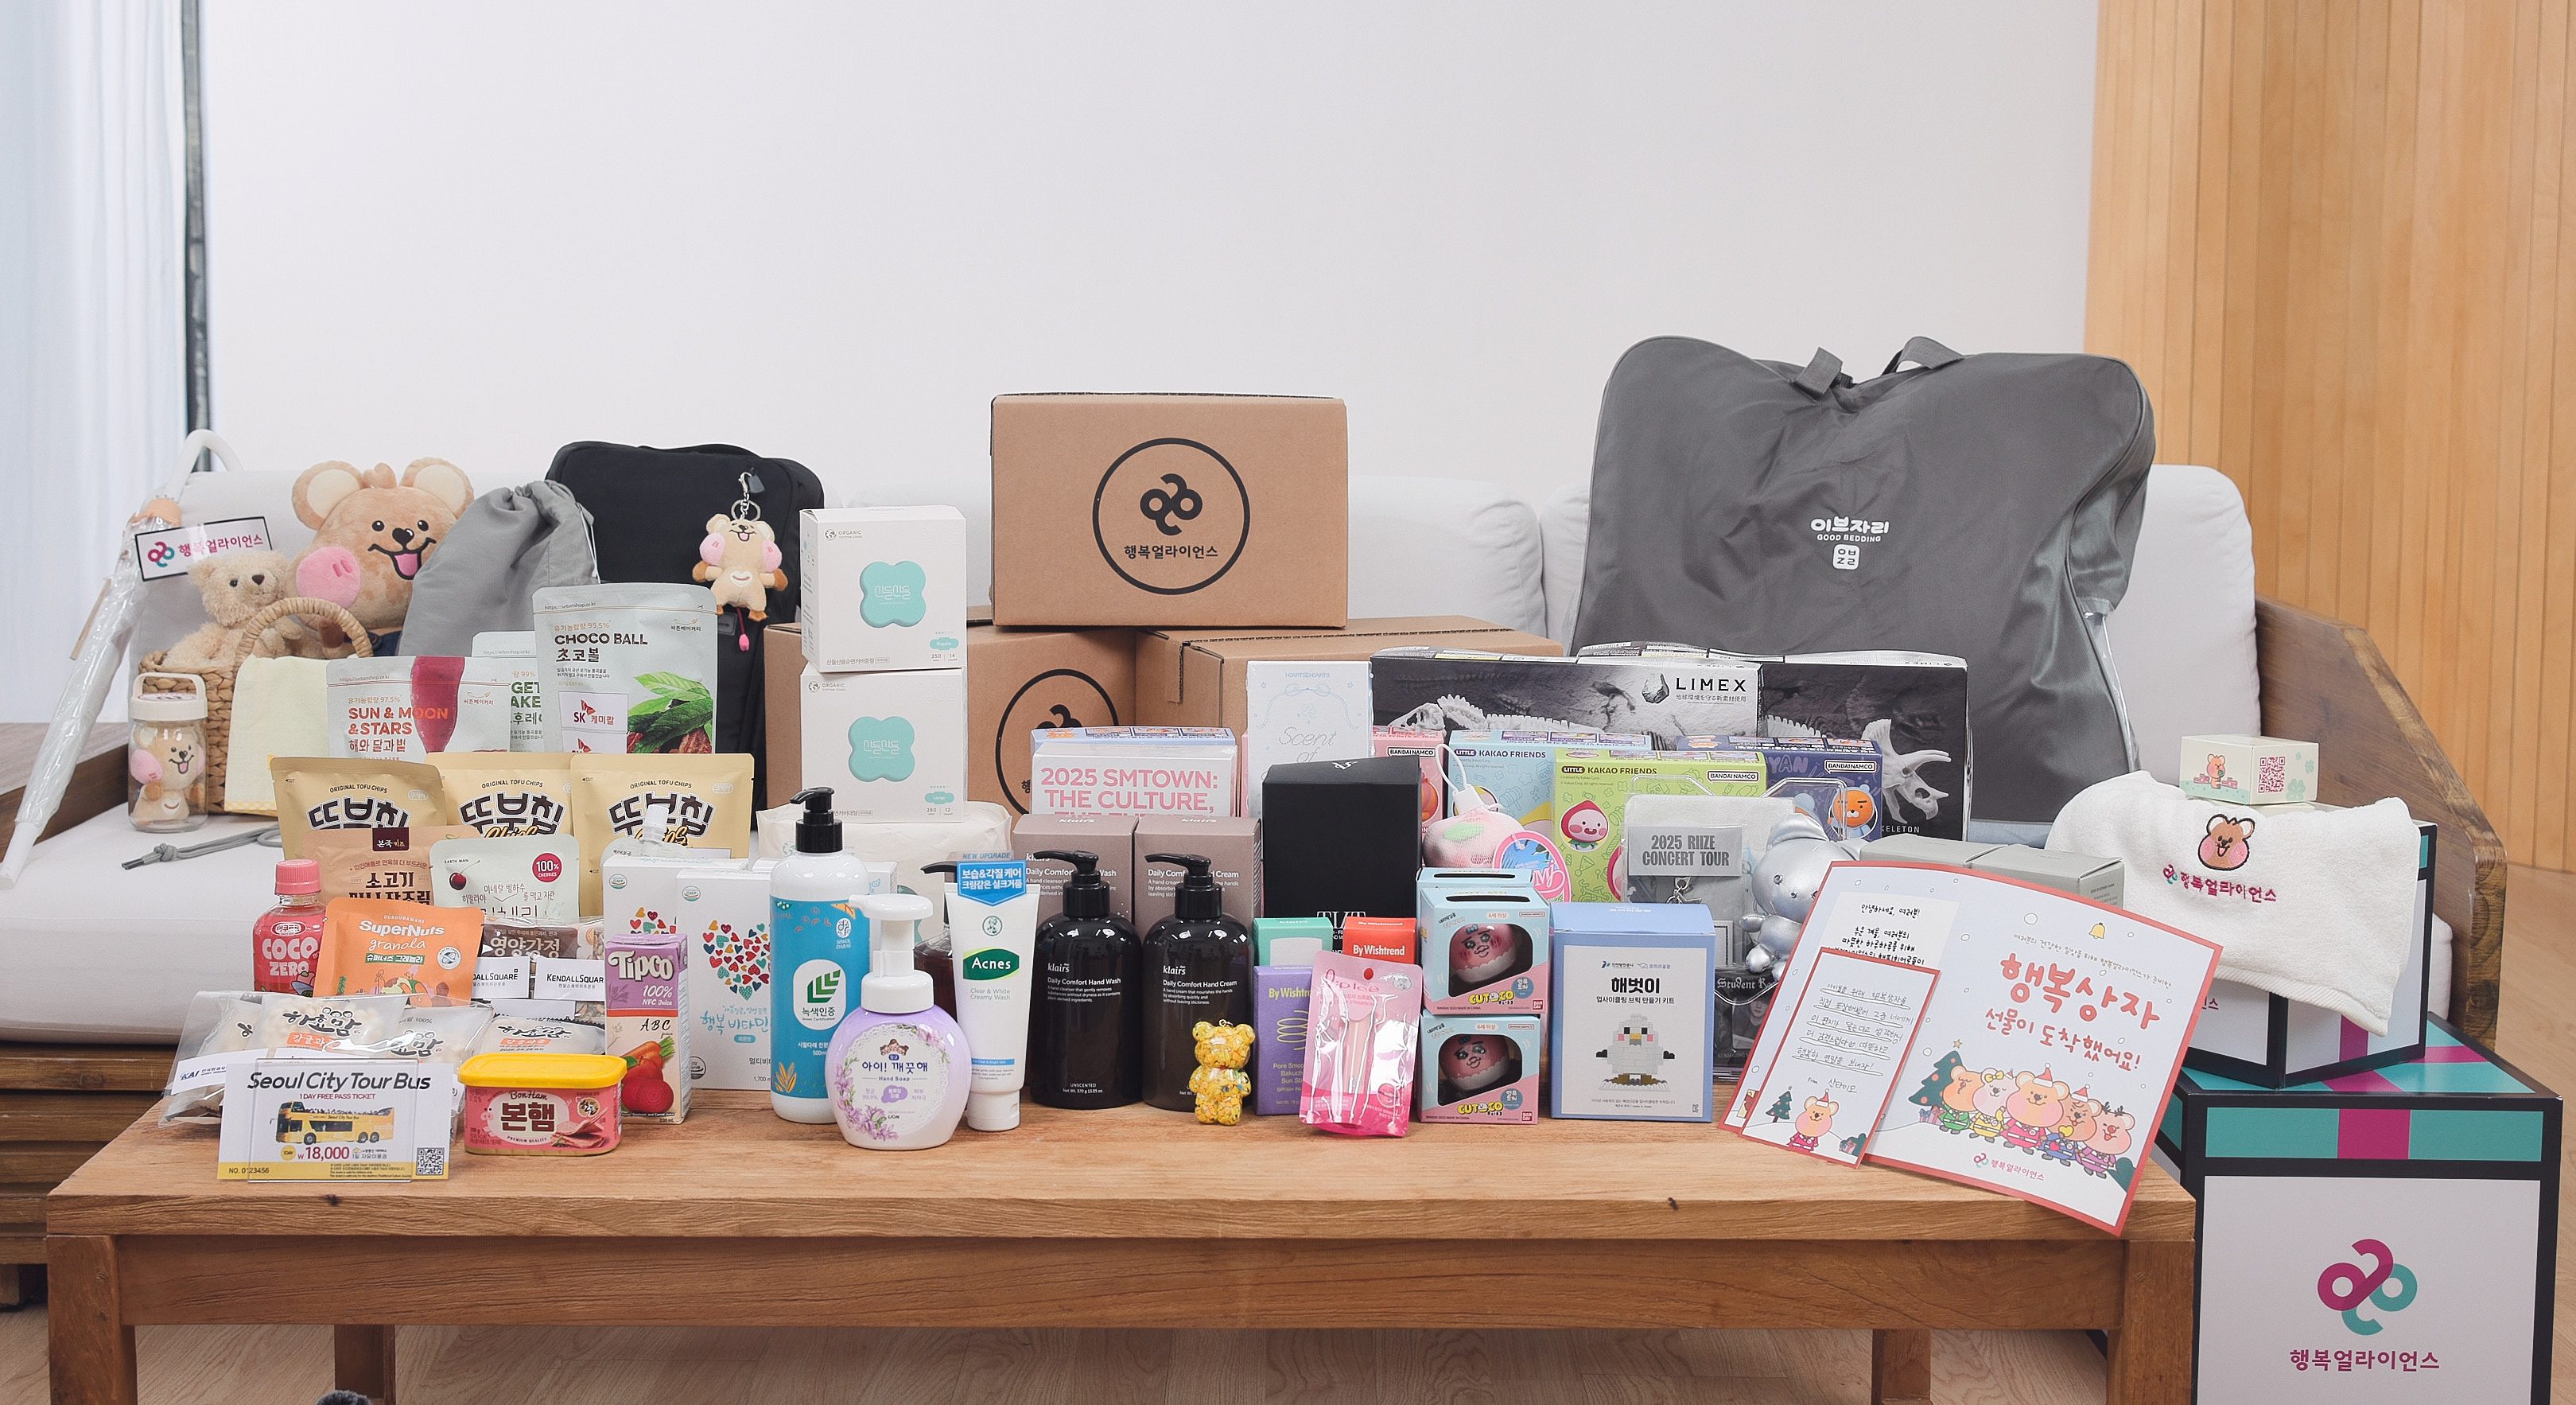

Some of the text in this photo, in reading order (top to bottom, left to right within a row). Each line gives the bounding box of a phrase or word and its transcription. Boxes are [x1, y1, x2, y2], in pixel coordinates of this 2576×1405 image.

[1810, 516, 1890, 534] 이브자리
[1124, 545, 1218, 559] 행복얼라이언스
[554, 633, 648, 645] CHOCO BALL
[555, 647, 600, 663] 초코볼
[1675, 677, 1746, 692] LIMEX
[348, 706, 449, 721] SUN & MOON
[573, 712, 586, 723] SK
[1279, 726, 1338, 746] Scent
[348, 739, 394, 753] 해와 달과
[1510, 750, 1547, 759] FRIENDS
[481, 780, 509, 788] ORIGINAL
[525, 780, 544, 788] CHIPS
[629, 780, 657, 789] ORIGINAL
[1041, 767, 1218, 789] 2025 SMTOWN:
[329, 784, 356, 794] ORIGINAL
[371, 784, 388, 794] CHIPS
[1044, 789, 1214, 813] THE CULTURE,
[460, 793, 564, 835] 뚜부칩
[1651, 835, 1715, 850] 2025 RIIZE
[1642, 851, 1731, 866] CONCERT TOUR
[536, 860, 559, 872] 100%
[365, 872, 414, 889] 소고기
[962, 867, 1022, 880] 보습&각질 케어
[1026, 869, 1043, 878] Daily
[1148, 869, 1164, 878] Daily
[484, 883, 526, 894] 미네랄 빙하수
[962, 879, 1023, 889] 크림같은 실크거품
[2179, 870, 2277, 903] 행복얼라이언스
[462, 893, 488, 905] 히말라야
[1860, 903, 1921, 919] 안녕하세요, 여러분!
[359, 920, 445, 938] SuperNuts
[1883, 928, 1910, 940] 여러분의
[262, 936, 318, 960] COCO
[368, 938, 427, 952] granola
[1353, 944, 1405, 957] By Wishtrend
[1842, 936, 1916, 952] 따뜻한 하루하루를 위해
[971, 956, 1012, 970] Acnes
[2013, 933, 2038, 945] 여러분의
[2083, 952, 2098, 963] 위해
[2099, 957, 2151, 981] 행복얼라이언스가
[269, 960, 309, 976] ZERO
[607, 950, 674, 982] Tipco
[1047, 963, 1070, 973] klairs
[1163, 965, 1187, 975] klairs
[1047, 977, 1061, 986] Daily
[1163, 979, 1176, 988] Daily
[1219, 979, 1237, 988] Cream
[1610, 976, 1660, 994] 해벗이
[1717, 977, 1756, 990] Student
[643, 985, 673, 998] 100%
[1269, 987, 1280, 1000] By
[1851, 987, 1865, 999] 위해
[2000, 952, 2161, 1030] 행복상자
[1818, 996, 1832, 1008] 직접
[802, 1006, 836, 1018] 녹색인증
[639, 1018, 672, 1032] ABC
[699, 1010, 770, 1035] 행복 비타민
[1820, 1016, 1840, 1028] 편지가
[1806, 1029, 1815, 1037] 더
[1984, 1007, 2141, 1072] 선물이 도착했어요!
[1797, 1046, 1820, 1061] 행복한
[861, 1061, 929, 1074] 아이! 깨끗해
[247, 1072, 432, 1093] Seoul City Tour Bus
[500, 1102, 555, 1132] 본햄
[305, 1146, 350, 1162] 18,000
[1991, 1158, 2046, 1182] 행복얼라이언스
[2290, 1349, 2440, 1372] 행복얼라이언스
